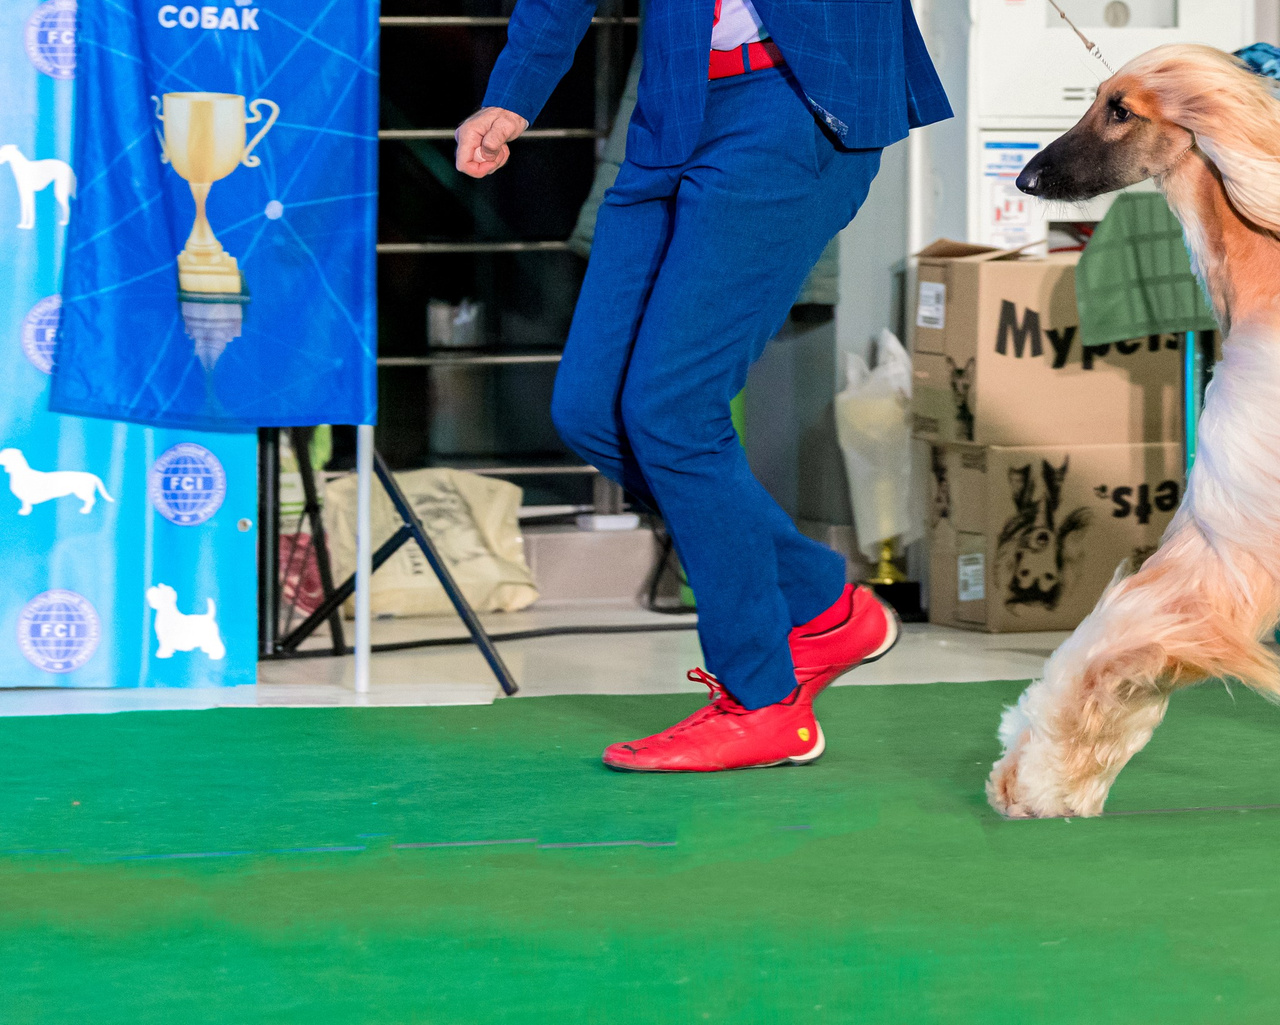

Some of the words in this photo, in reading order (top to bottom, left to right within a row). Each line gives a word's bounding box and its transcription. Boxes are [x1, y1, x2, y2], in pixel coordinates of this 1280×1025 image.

[158, 5, 260, 30] СОБАК
[47, 31, 75, 44] FC
[169, 477, 204, 491] FCI
[40, 624, 76, 637] FCI
